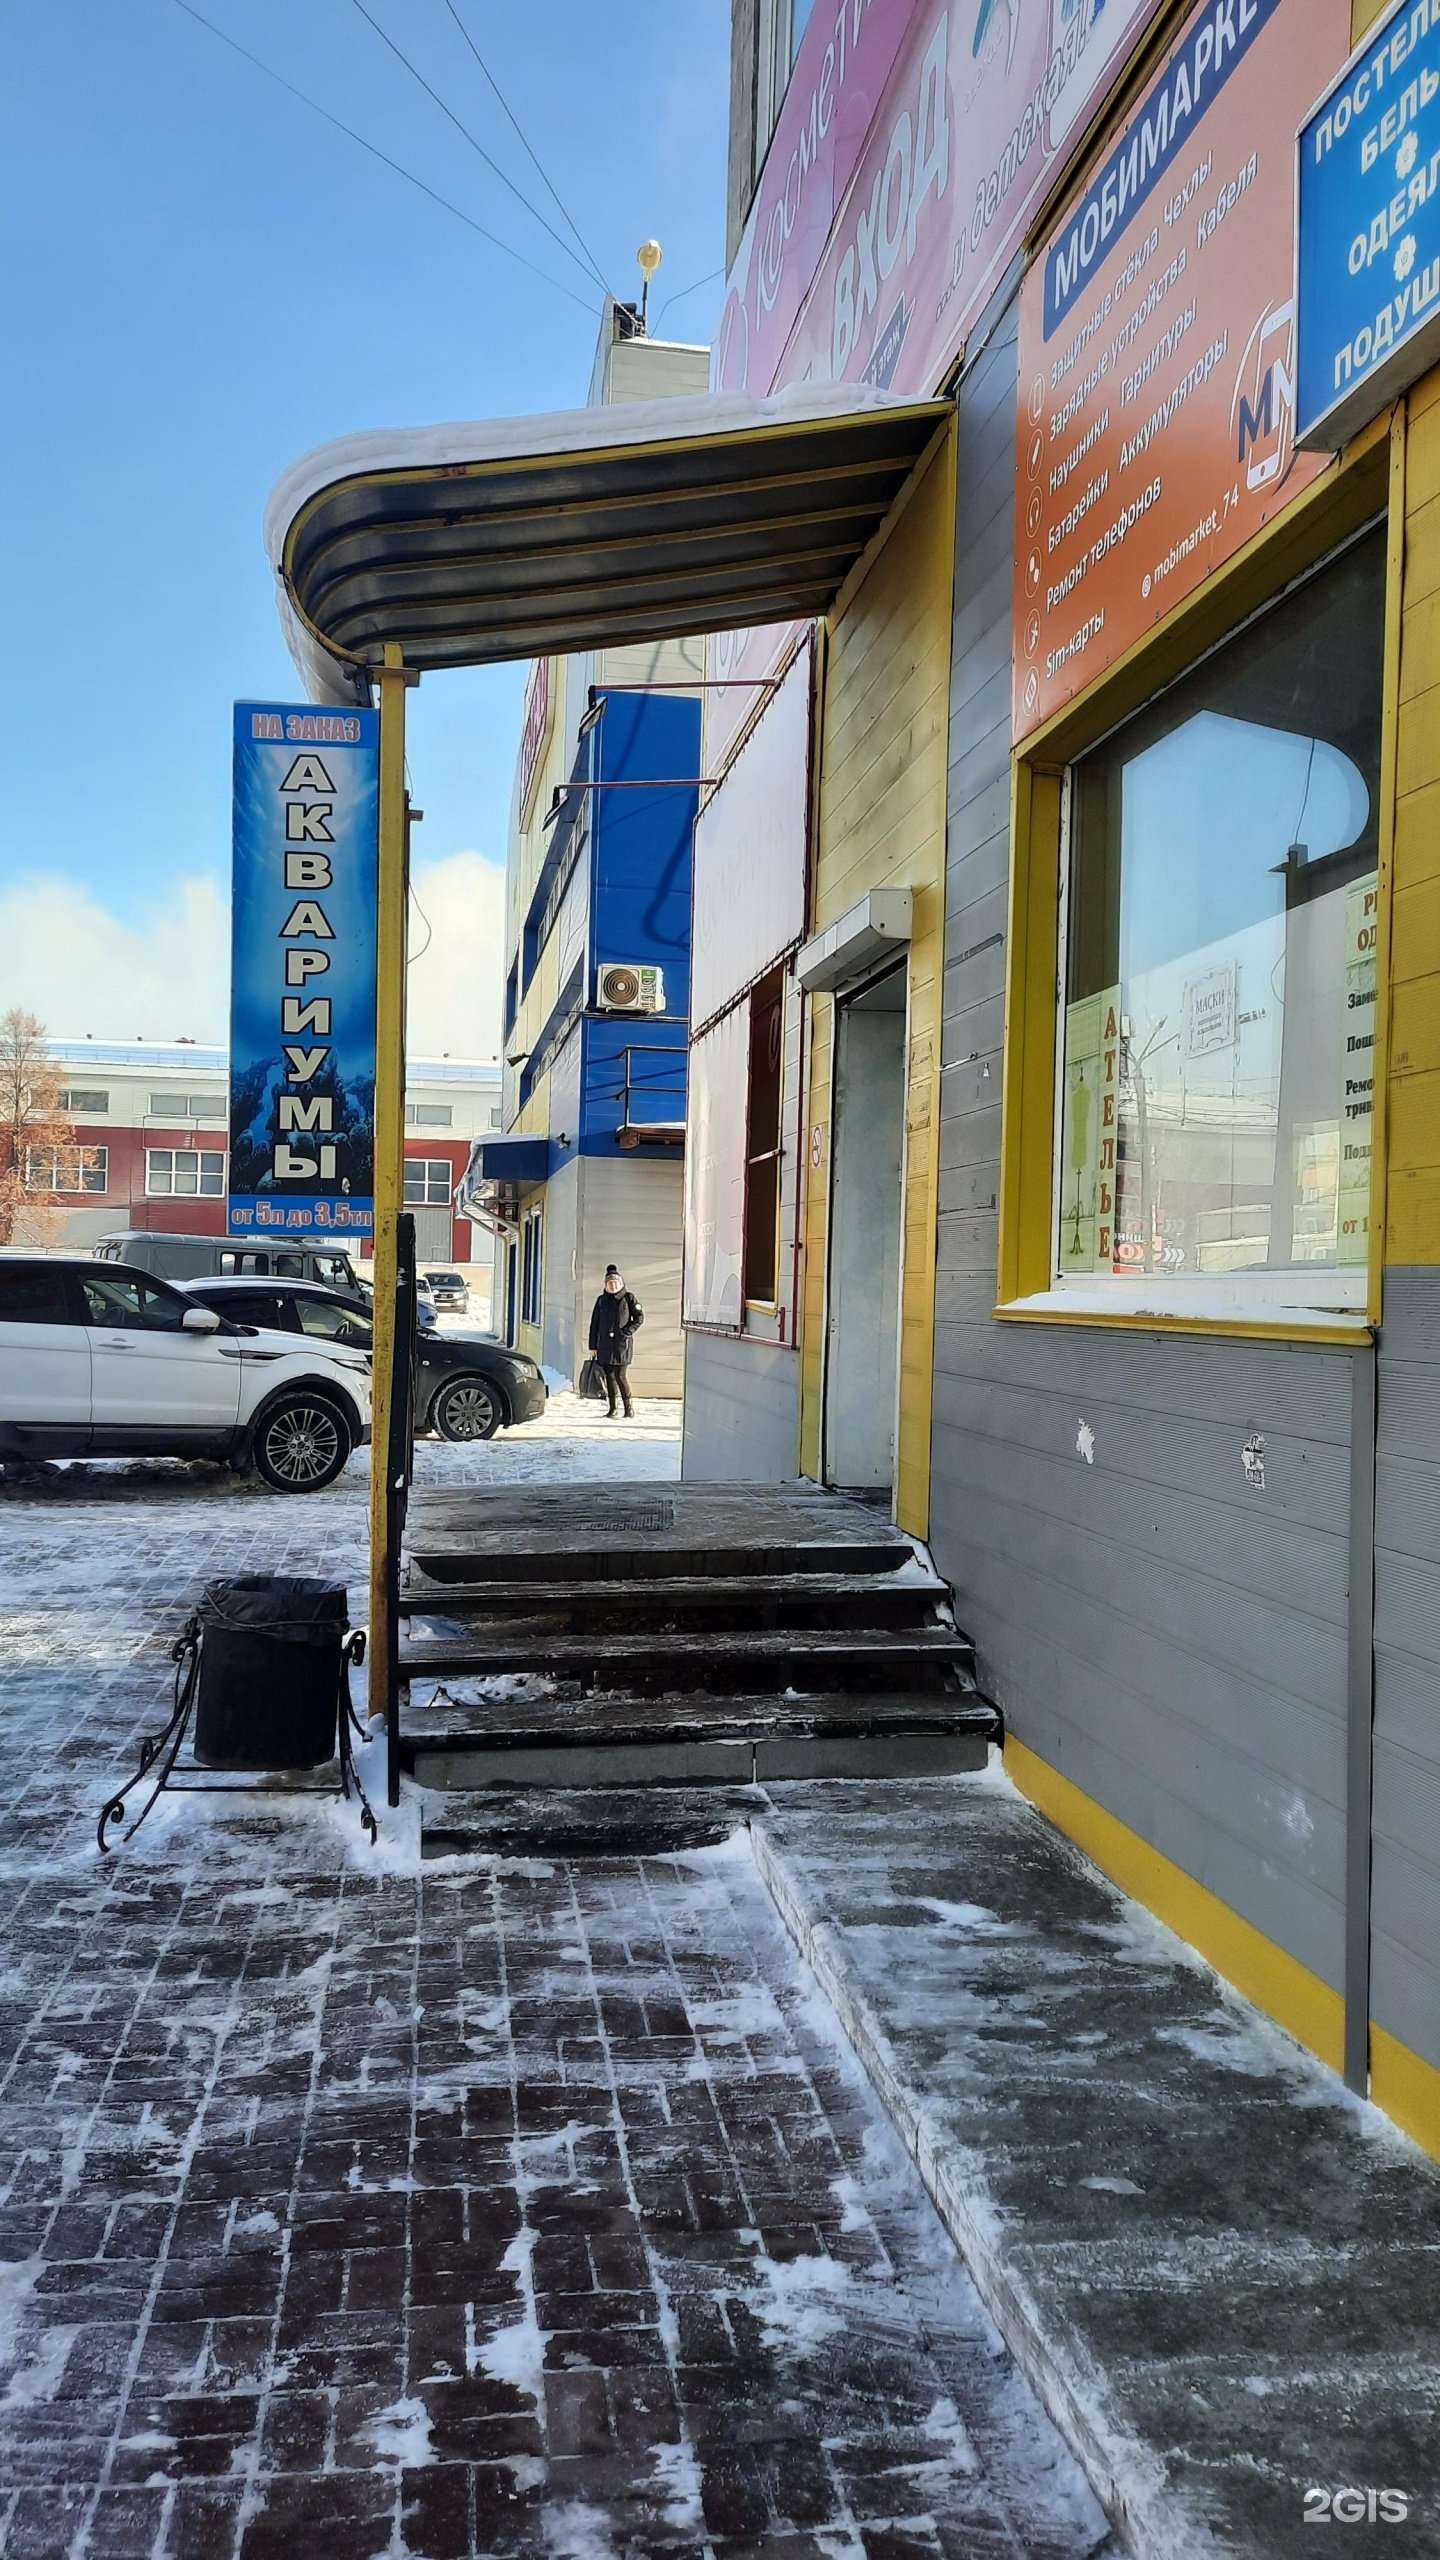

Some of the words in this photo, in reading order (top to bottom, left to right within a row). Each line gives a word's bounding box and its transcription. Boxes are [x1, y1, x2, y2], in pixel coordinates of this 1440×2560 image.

[831, 8, 950, 383] ВХОД
[1050, 351, 1109, 441] Зарядные
[1111, 247, 1188, 368] устройства
[1197, 151, 1258, 249] Кабеля
[1051, 293, 1112, 390] Защитные
[1114, 227, 1160, 301] стёкла
[1163, 150, 1213, 228] Чехлы
[1048, 468, 1109, 554] Батарейки
[1119, 327, 1229, 473] Аккумуляторы
[1050, 407, 1110, 496] Наушники
[1120, 297, 1198, 409] Гарнитуры
[1046, 554, 1088, 614] Ремонт
[1090, 476, 1162, 566] телефонов
[1154, 482, 1239, 584] mobimarket_74
[252, 713, 283, 739] НА
[287, 715, 361, 742] ЗАКАЗ
[1046, 607, 1105, 679] Sim-карты
[274, 754, 337, 1181] АКВАРИУМЫ
[231, 1208, 254, 1225] от
[286, 1208, 312, 1228] до
[1098, 1006, 1117, 1258] АТЕЛЬЕ
